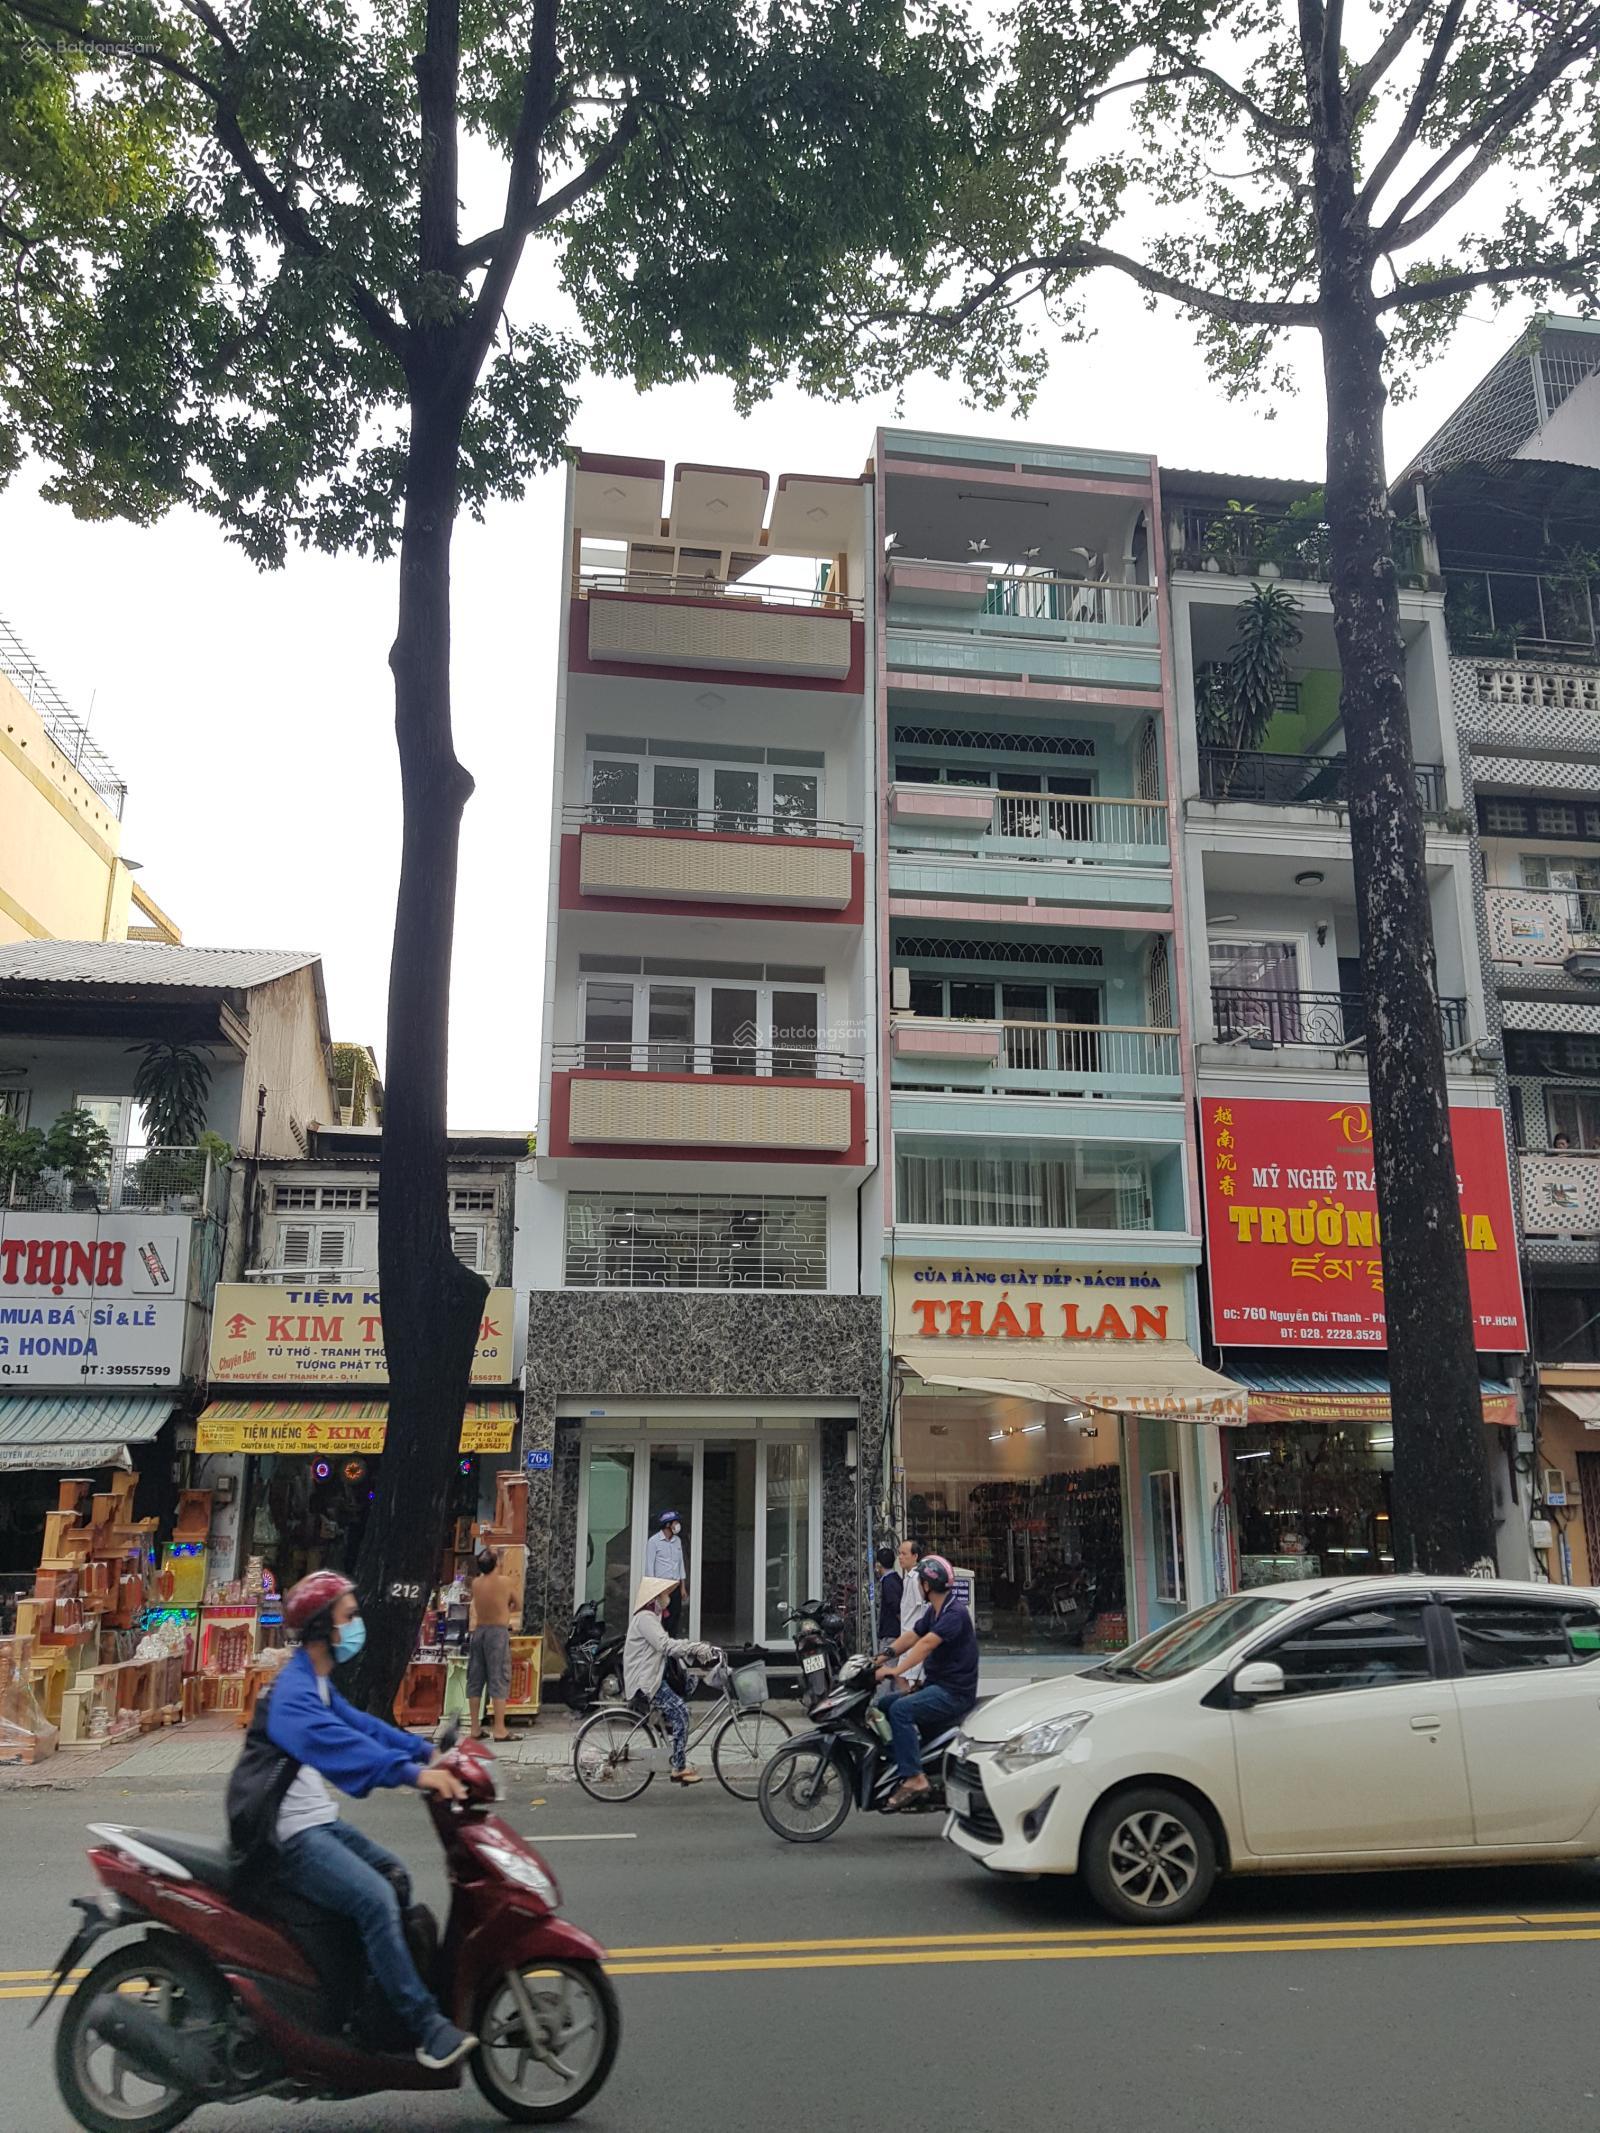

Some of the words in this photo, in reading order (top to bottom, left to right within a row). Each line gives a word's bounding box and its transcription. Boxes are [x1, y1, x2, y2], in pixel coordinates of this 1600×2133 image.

[1286, 1164, 1338, 1194] NGHỆ
[1, 1239, 126, 1296] THỊNH
[951, 1266, 997, 1284] HÀNG
[1000, 1268, 1038, 1285] GIÀY
[1042, 1268, 1072, 1286] DÉP
[1084, 1269, 1126, 1288] BÁCH
[1130, 1271, 1162, 1288] HÓA
[286, 1289, 353, 1307] TIỆM
[1, 1308, 44, 1326] MUA
[93, 1303, 114, 1326] SỈ
[116, 1312, 130, 1326] &
[133, 1304, 157, 1326] LẺ
[911, 1291, 1045, 1338] THÁI
[1061, 1303, 1169, 1340] LAN
[1242, 1307, 1267, 1321] 760
[1269, 1308, 1309, 1322] Nguyễn
[1332, 1312, 1362, 1323] Thanh
[1479, 1315, 1518, 1327] TP.HCM
[225, 1313, 257, 1339] 金
[265, 1315, 345, 1342] KIM
[1280, 1327, 1298, 1339] ĐT:
[1326, 1329, 1382, 1341] 2228.3528
[19, 1337, 98, 1356] HONDA
[267, 1344, 283, 1357] TỦ
[321, 1348, 361, 1357] TRANH
[2, 1364, 29, 1376] Q.11
[106, 1365, 171, 1376] 39557599
[271, 1371, 287, 1380] CHÍ
[296, 1360, 336, 1374] TƯỢNG
[242, 1423, 268, 1440] TIỆM
[327, 1426, 372, 1440] KIM
[530, 1453, 549, 1464] 764
[391, 1583, 420, 1598] 212
